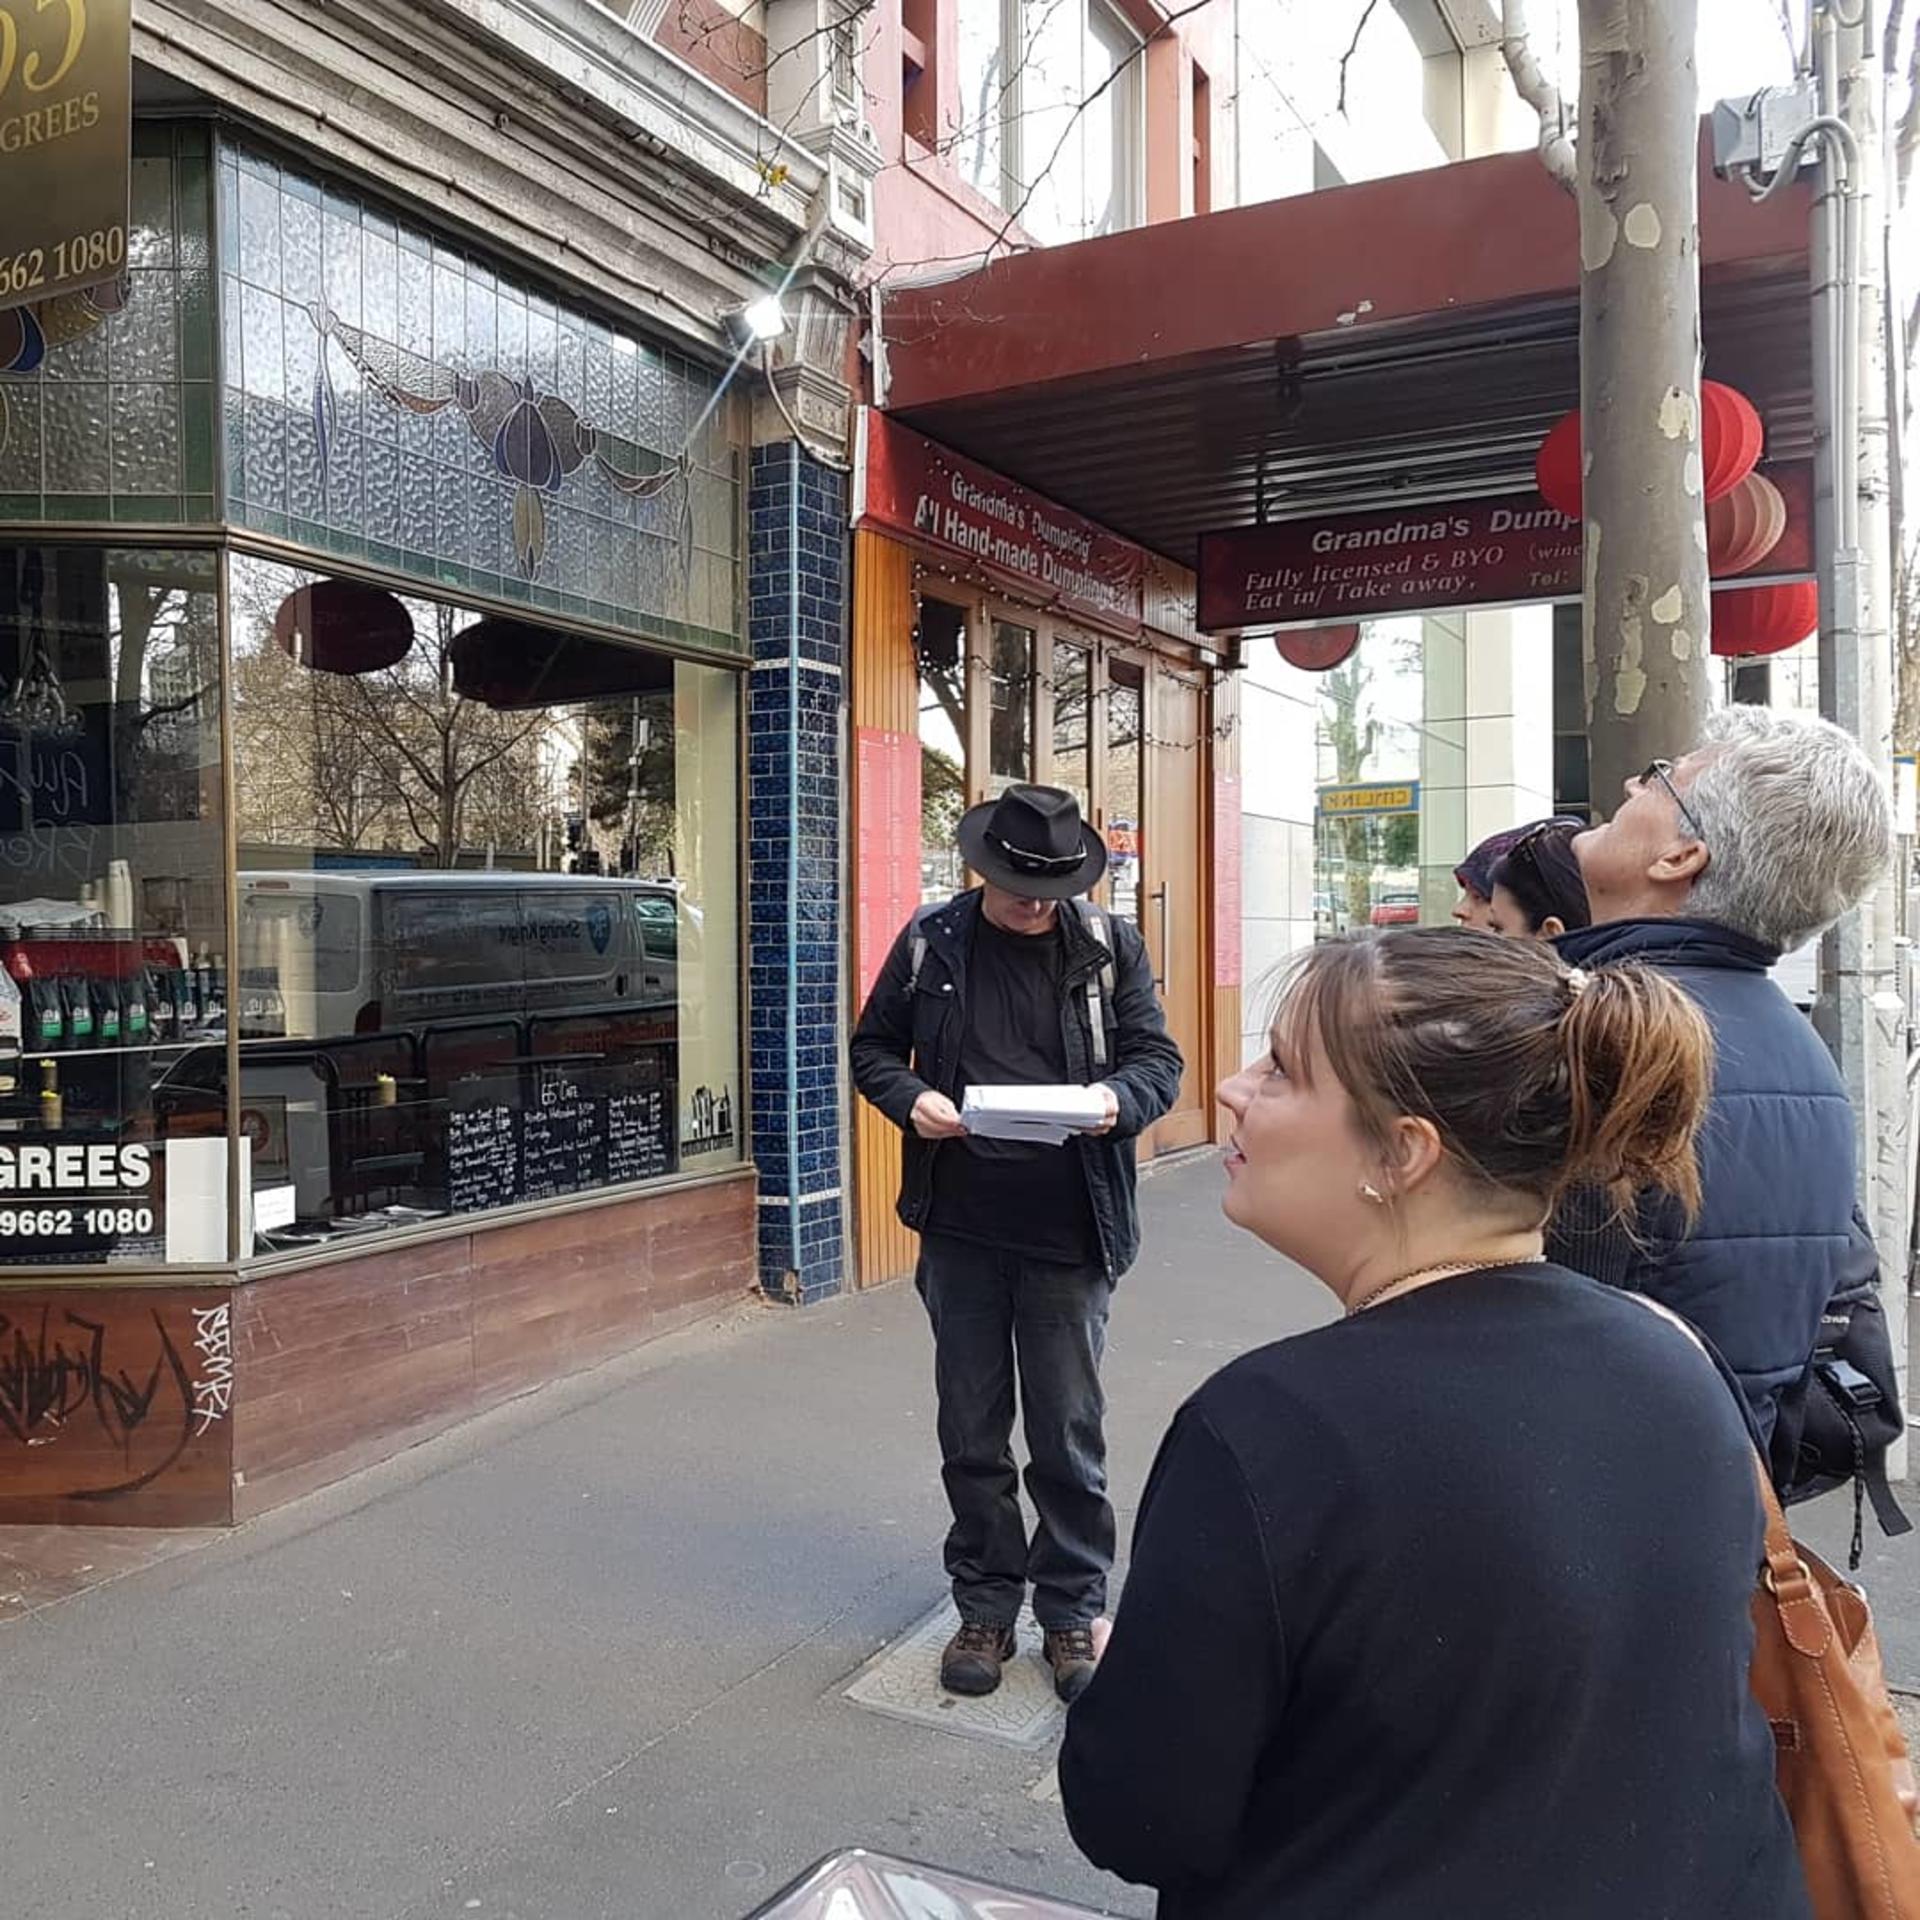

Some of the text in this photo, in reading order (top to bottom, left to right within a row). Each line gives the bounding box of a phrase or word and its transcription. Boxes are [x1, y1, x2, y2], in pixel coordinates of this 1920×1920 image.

[0, 91, 99, 151] GREES
[53, 226, 124, 281] 1080
[944, 507, 1039, 576] Hand-made
[952, 471, 1092, 564] Grandma's Dumpling
[1311, 515, 1470, 553] Grandma's
[1245, 568, 1302, 591] Fully
[1312, 555, 1412, 583] licensed
[1421, 553, 1440, 572] &
[1451, 545, 1504, 568] BYO
[1245, 591, 1283, 611] Eat
[1334, 580, 1391, 601] Take
[0, 1208, 153, 1236] 9662 1080
